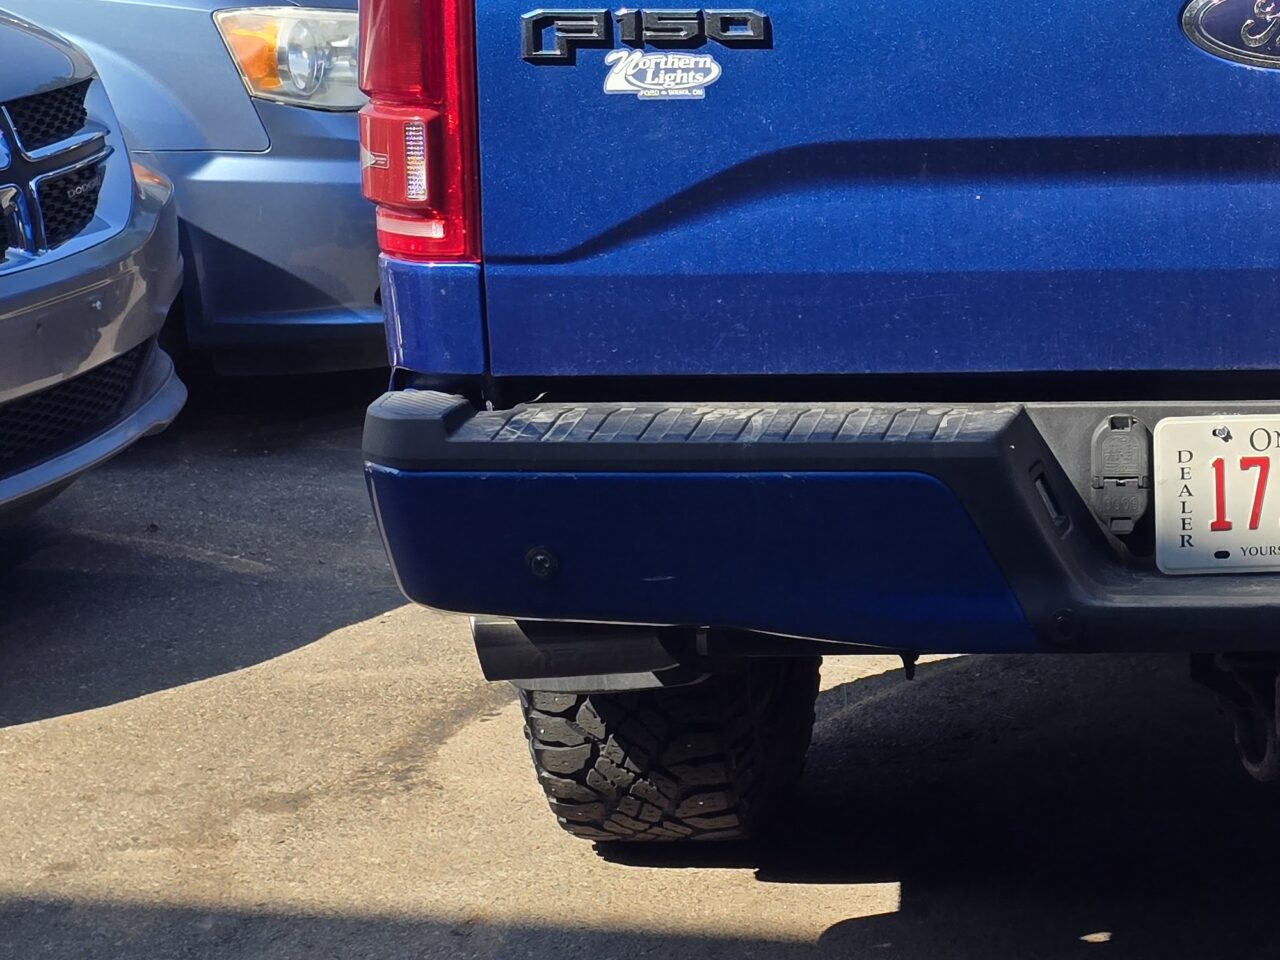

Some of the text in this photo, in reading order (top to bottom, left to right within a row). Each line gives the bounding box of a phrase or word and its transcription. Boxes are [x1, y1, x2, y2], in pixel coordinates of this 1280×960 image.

[606, 50, 712, 76] Northern
[644, 68, 705, 88] Lights
[1177, 449, 1195, 548] DEALER
